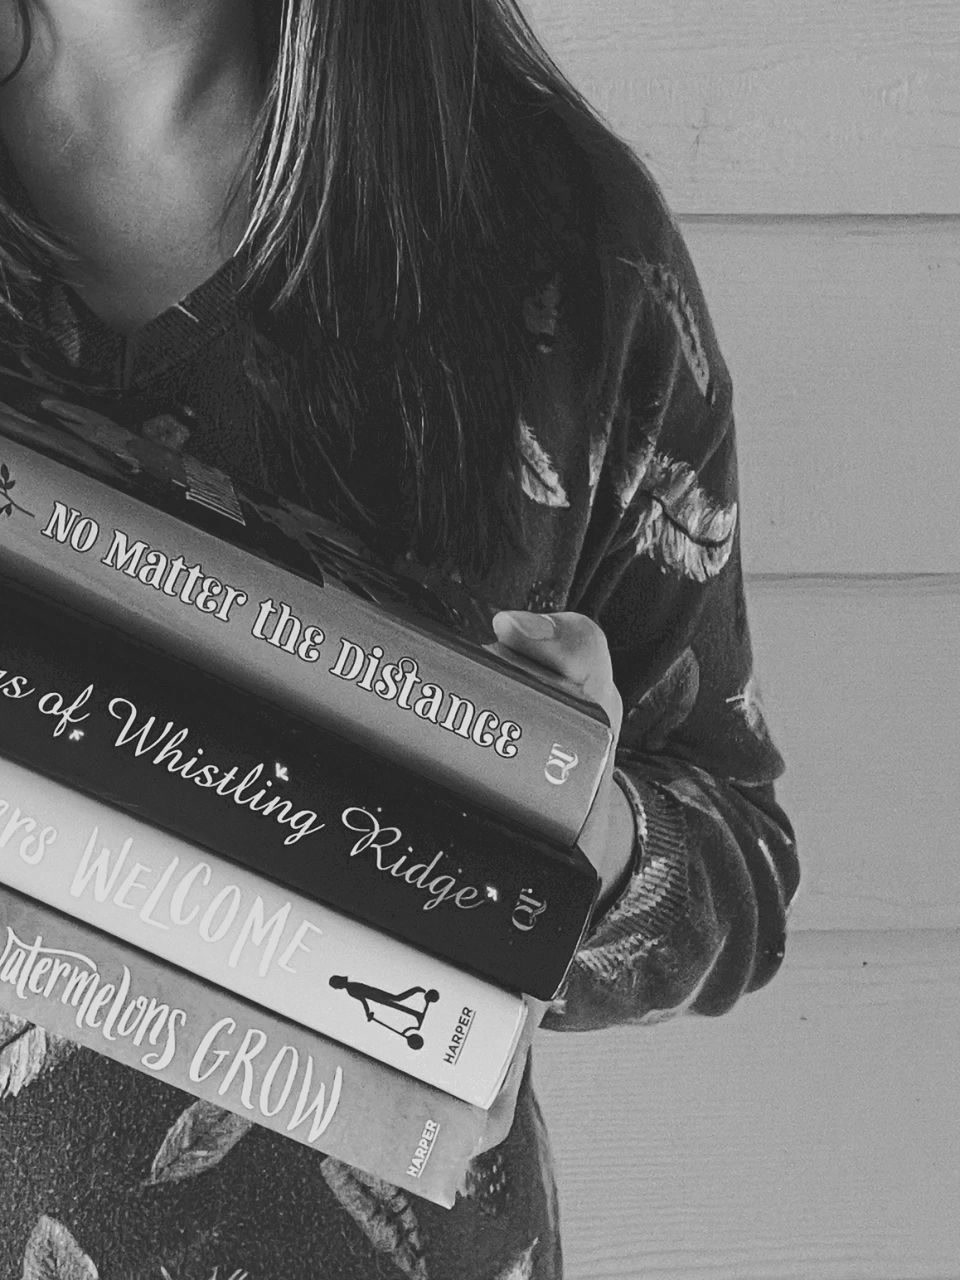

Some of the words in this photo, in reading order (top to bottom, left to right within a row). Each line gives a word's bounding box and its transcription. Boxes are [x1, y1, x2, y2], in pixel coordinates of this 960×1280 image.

[102, 529, 247, 622] Matter
[251, 598, 326, 662] the
[329, 637, 522, 758] Distance
[38, 684, 95, 738] of
[108, 697, 325, 845] Whistling
[341, 806, 485, 910] Ridge
[70, 825, 323, 977] WELCOME
[188, 1017, 343, 1143] GROW
[442, 1006, 474, 1064] HARPER
[406, 1119, 438, 1177] HARPER
